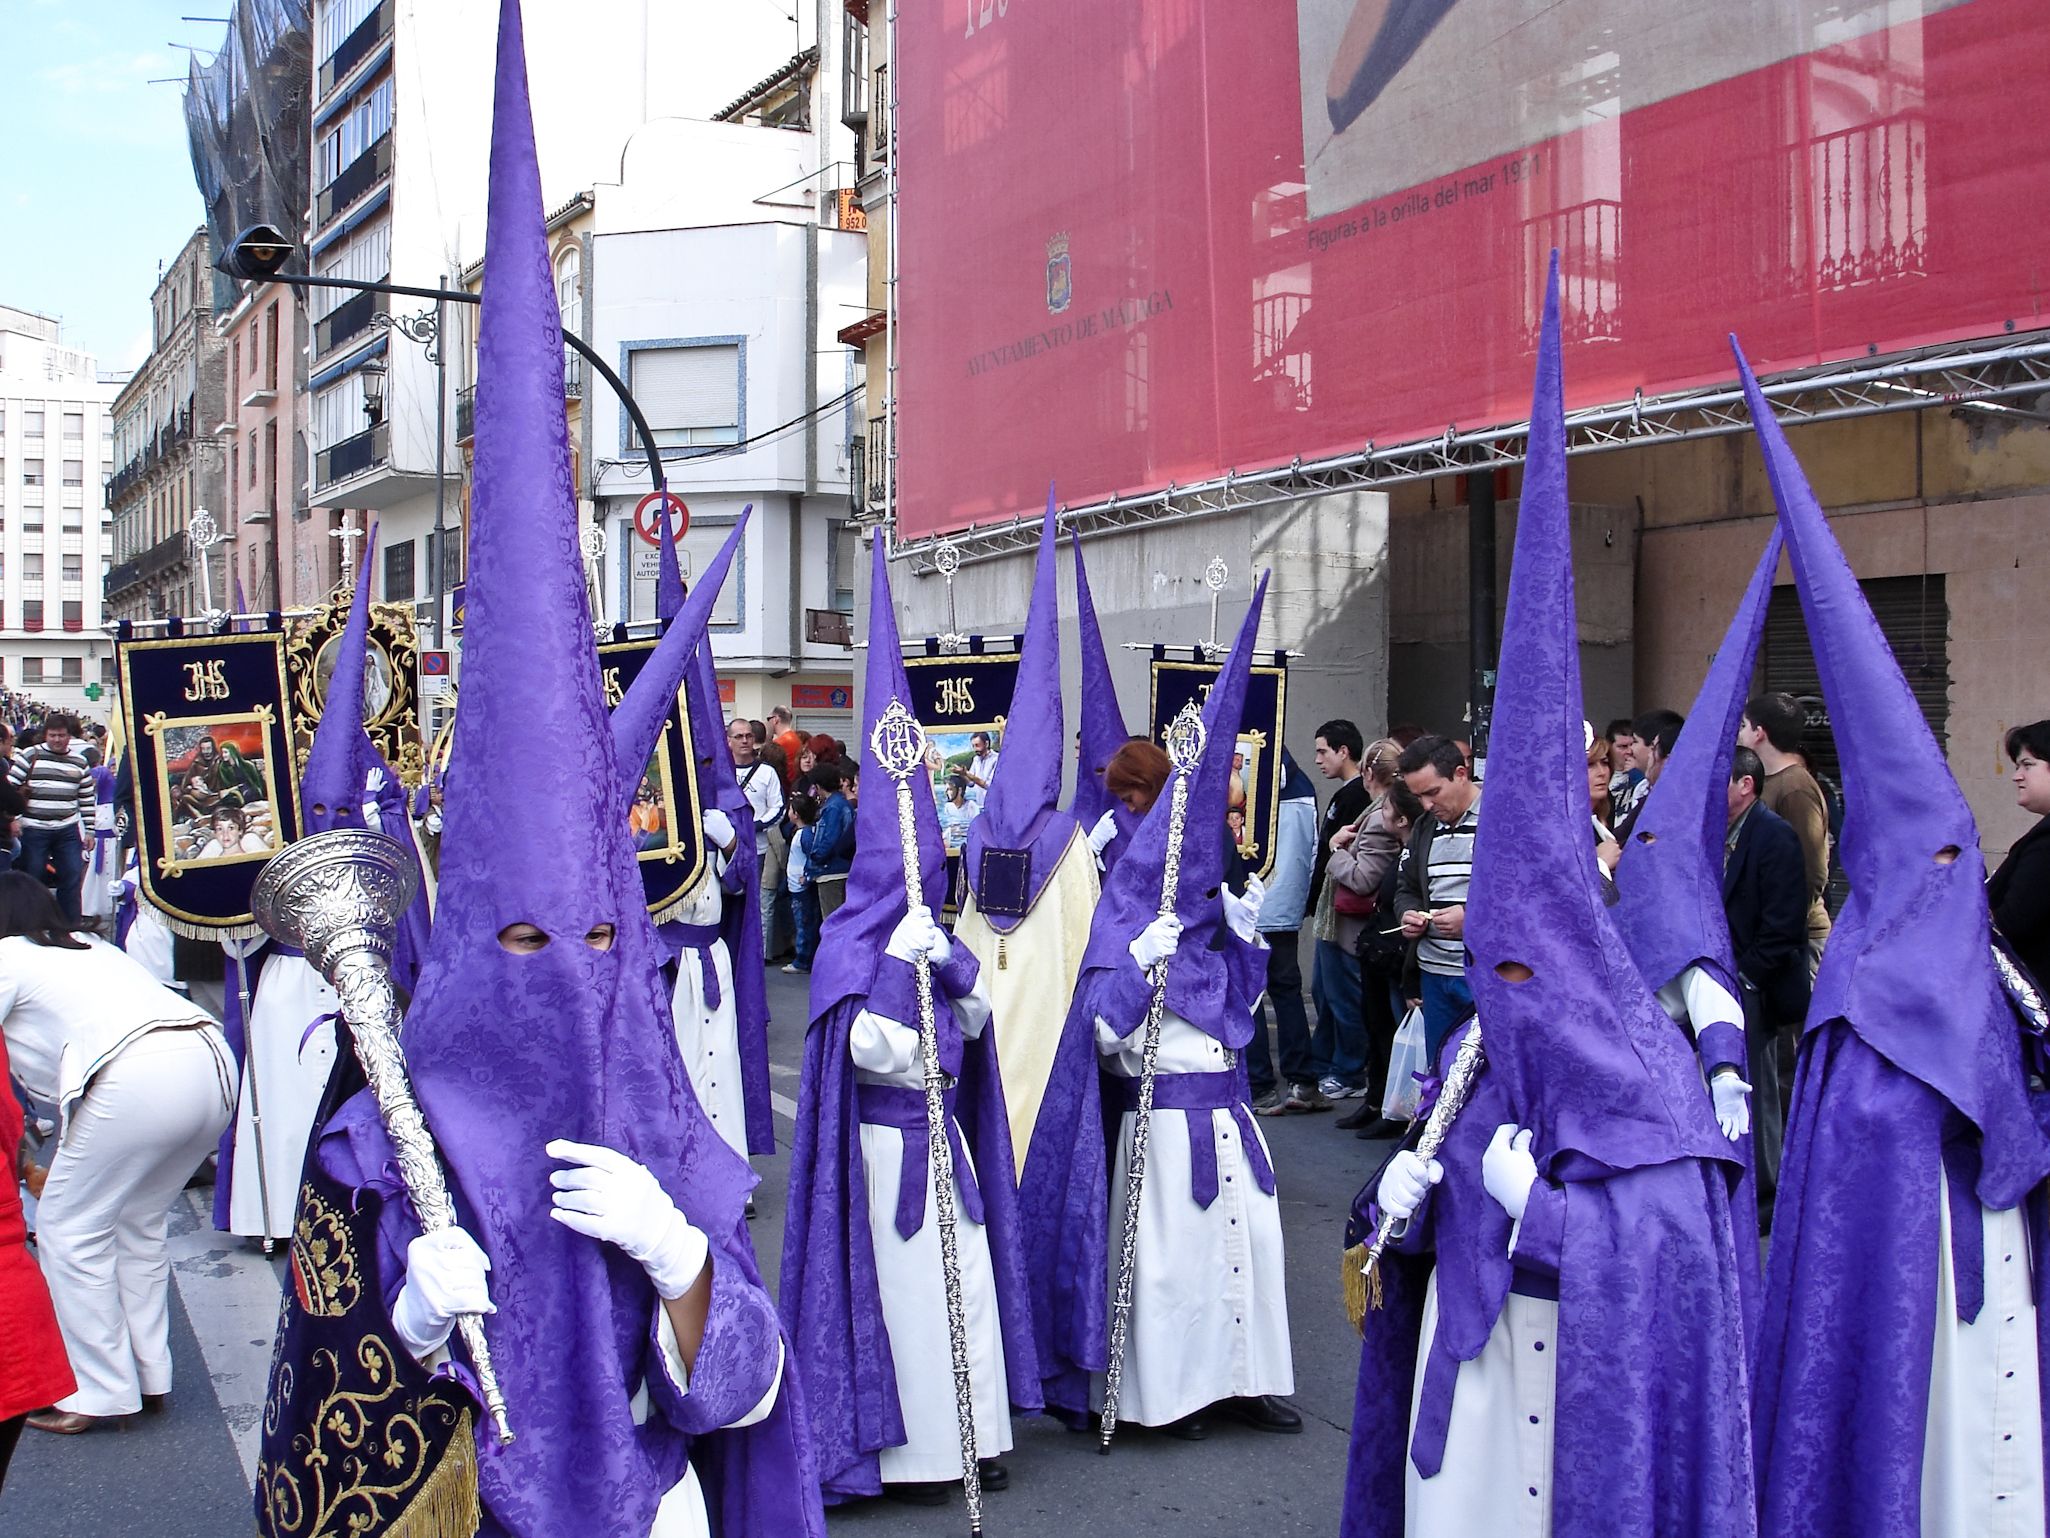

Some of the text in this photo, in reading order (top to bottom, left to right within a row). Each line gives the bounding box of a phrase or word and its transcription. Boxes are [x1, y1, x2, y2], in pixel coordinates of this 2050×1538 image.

[1309, 221, 1357, 251] Figuras
[1361, 217, 1370, 232] a
[1374, 207, 1387, 227] la
[1391, 194, 1430, 222] orilla
[1435, 180, 1459, 209] del
[1464, 173, 1495, 197] mar
[1076, 315, 1097, 340] DE
